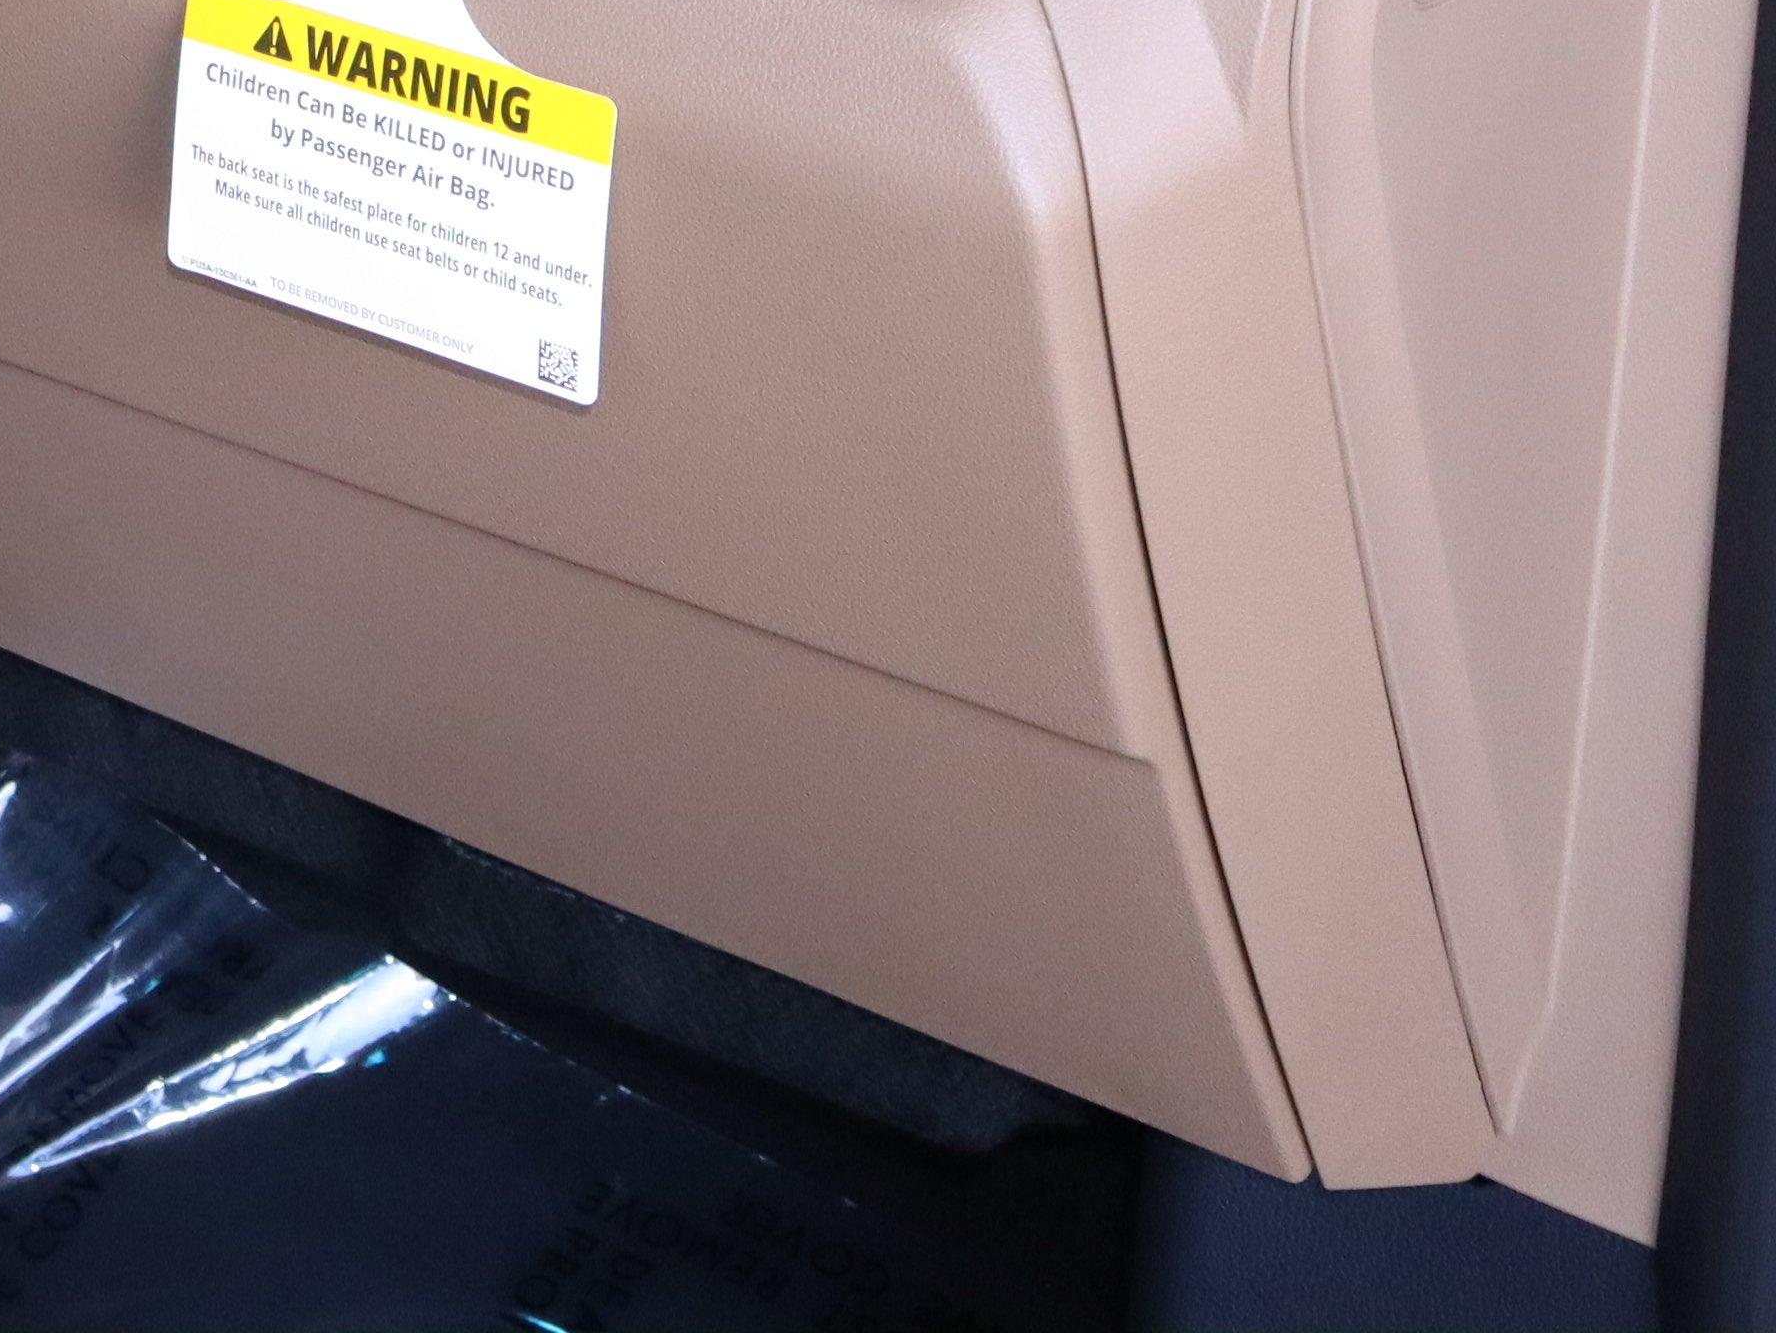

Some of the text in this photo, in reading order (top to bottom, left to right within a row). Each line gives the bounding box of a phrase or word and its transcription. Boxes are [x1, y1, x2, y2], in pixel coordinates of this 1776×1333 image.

[206, 62, 575, 191] Children Can Be KILLED or INJURED
[306, 24, 532, 134] WARNING
[192, 144, 593, 288] The back seat is the safest place for children 12 and under.
[271, 118, 495, 211] by Passenger Air Bag.
[215, 179, 563, 307] Make sure all children use seat belts or child seats.
[270, 276, 474, 355] TO BE REMOVED BY CUSTOMER ONLY
